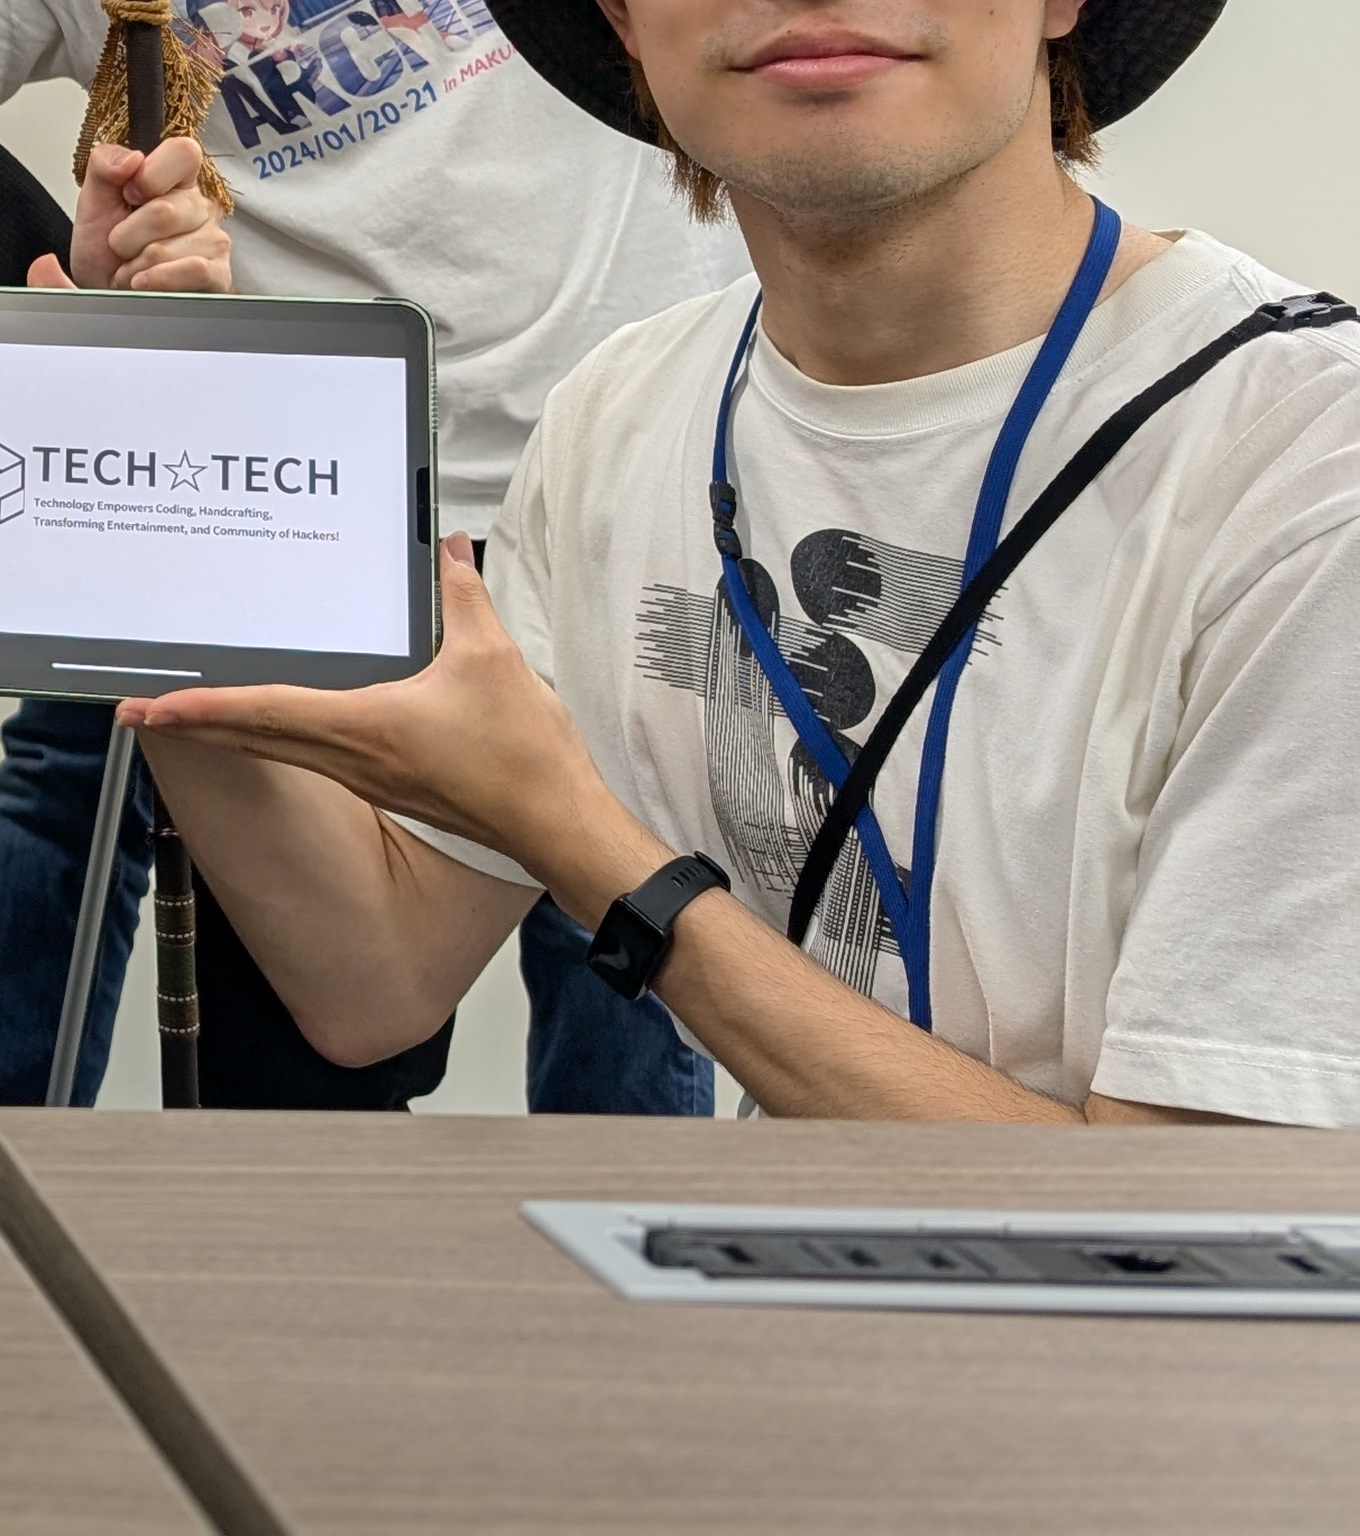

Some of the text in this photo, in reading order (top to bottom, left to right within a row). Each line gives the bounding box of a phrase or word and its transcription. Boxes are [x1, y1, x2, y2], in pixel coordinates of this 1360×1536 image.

[253, 44, 516, 180] 2024/01/20-21 in MAKU
[33, 497, 273, 521] Technology Empowers Coding, Handcrafting,
[33, 516, 340, 542] Transforming Entertainment, and Community of Hackers!
